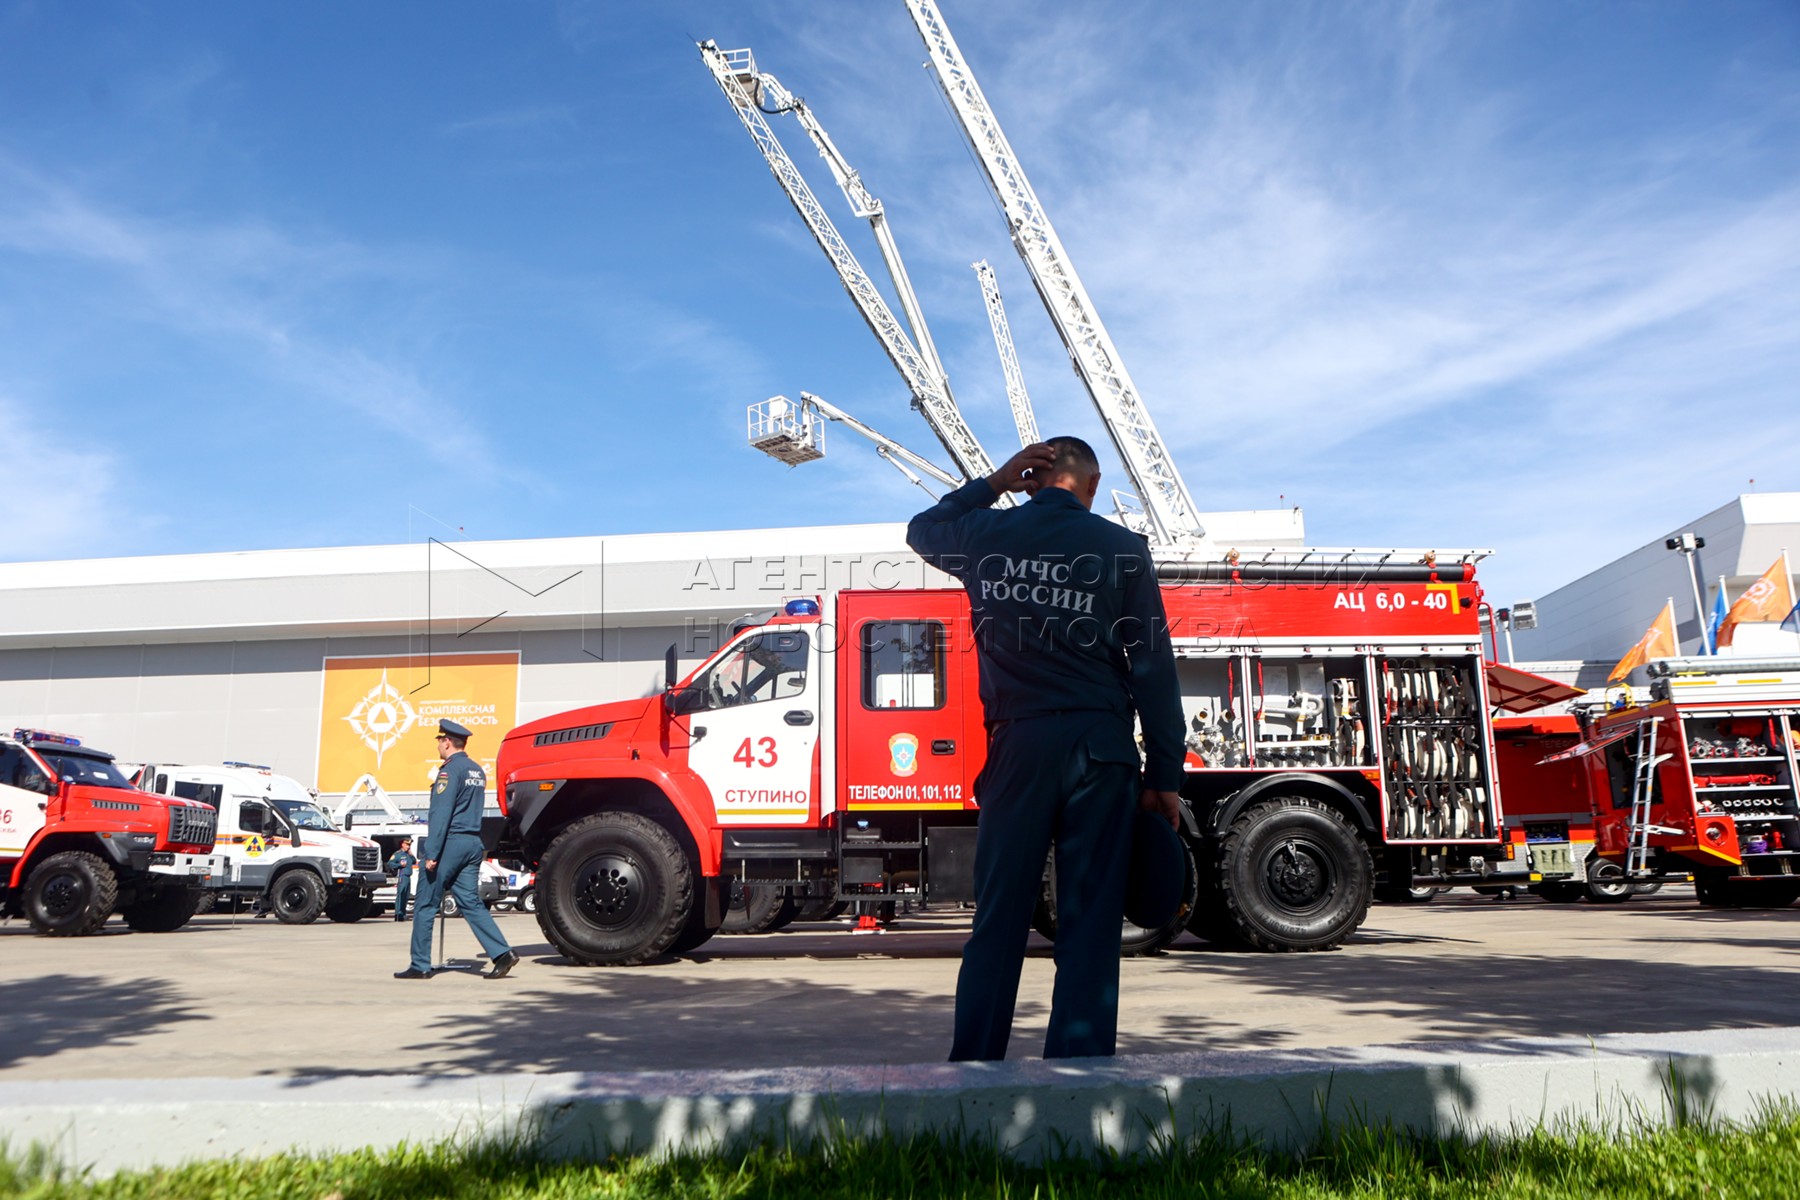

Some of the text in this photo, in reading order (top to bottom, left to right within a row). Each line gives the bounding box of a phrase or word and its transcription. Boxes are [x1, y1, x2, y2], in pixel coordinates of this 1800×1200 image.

[1002, 557, 1070, 583] МЧС
[980, 580, 1096, 614] РОССИИ
[1334, 592, 1366, 612] АЦ
[1375, 592, 1405, 612] 6,0
[1423, 592, 1447, 609] 40
[418, 705, 495, 715] КОМПЛЕКСНАЯ
[733, 736, 778, 768] 43
[725, 789, 807, 803] СТУПИНО
[849, 785, 961, 801] ТЕЛЕФОН 01, 101, 112
